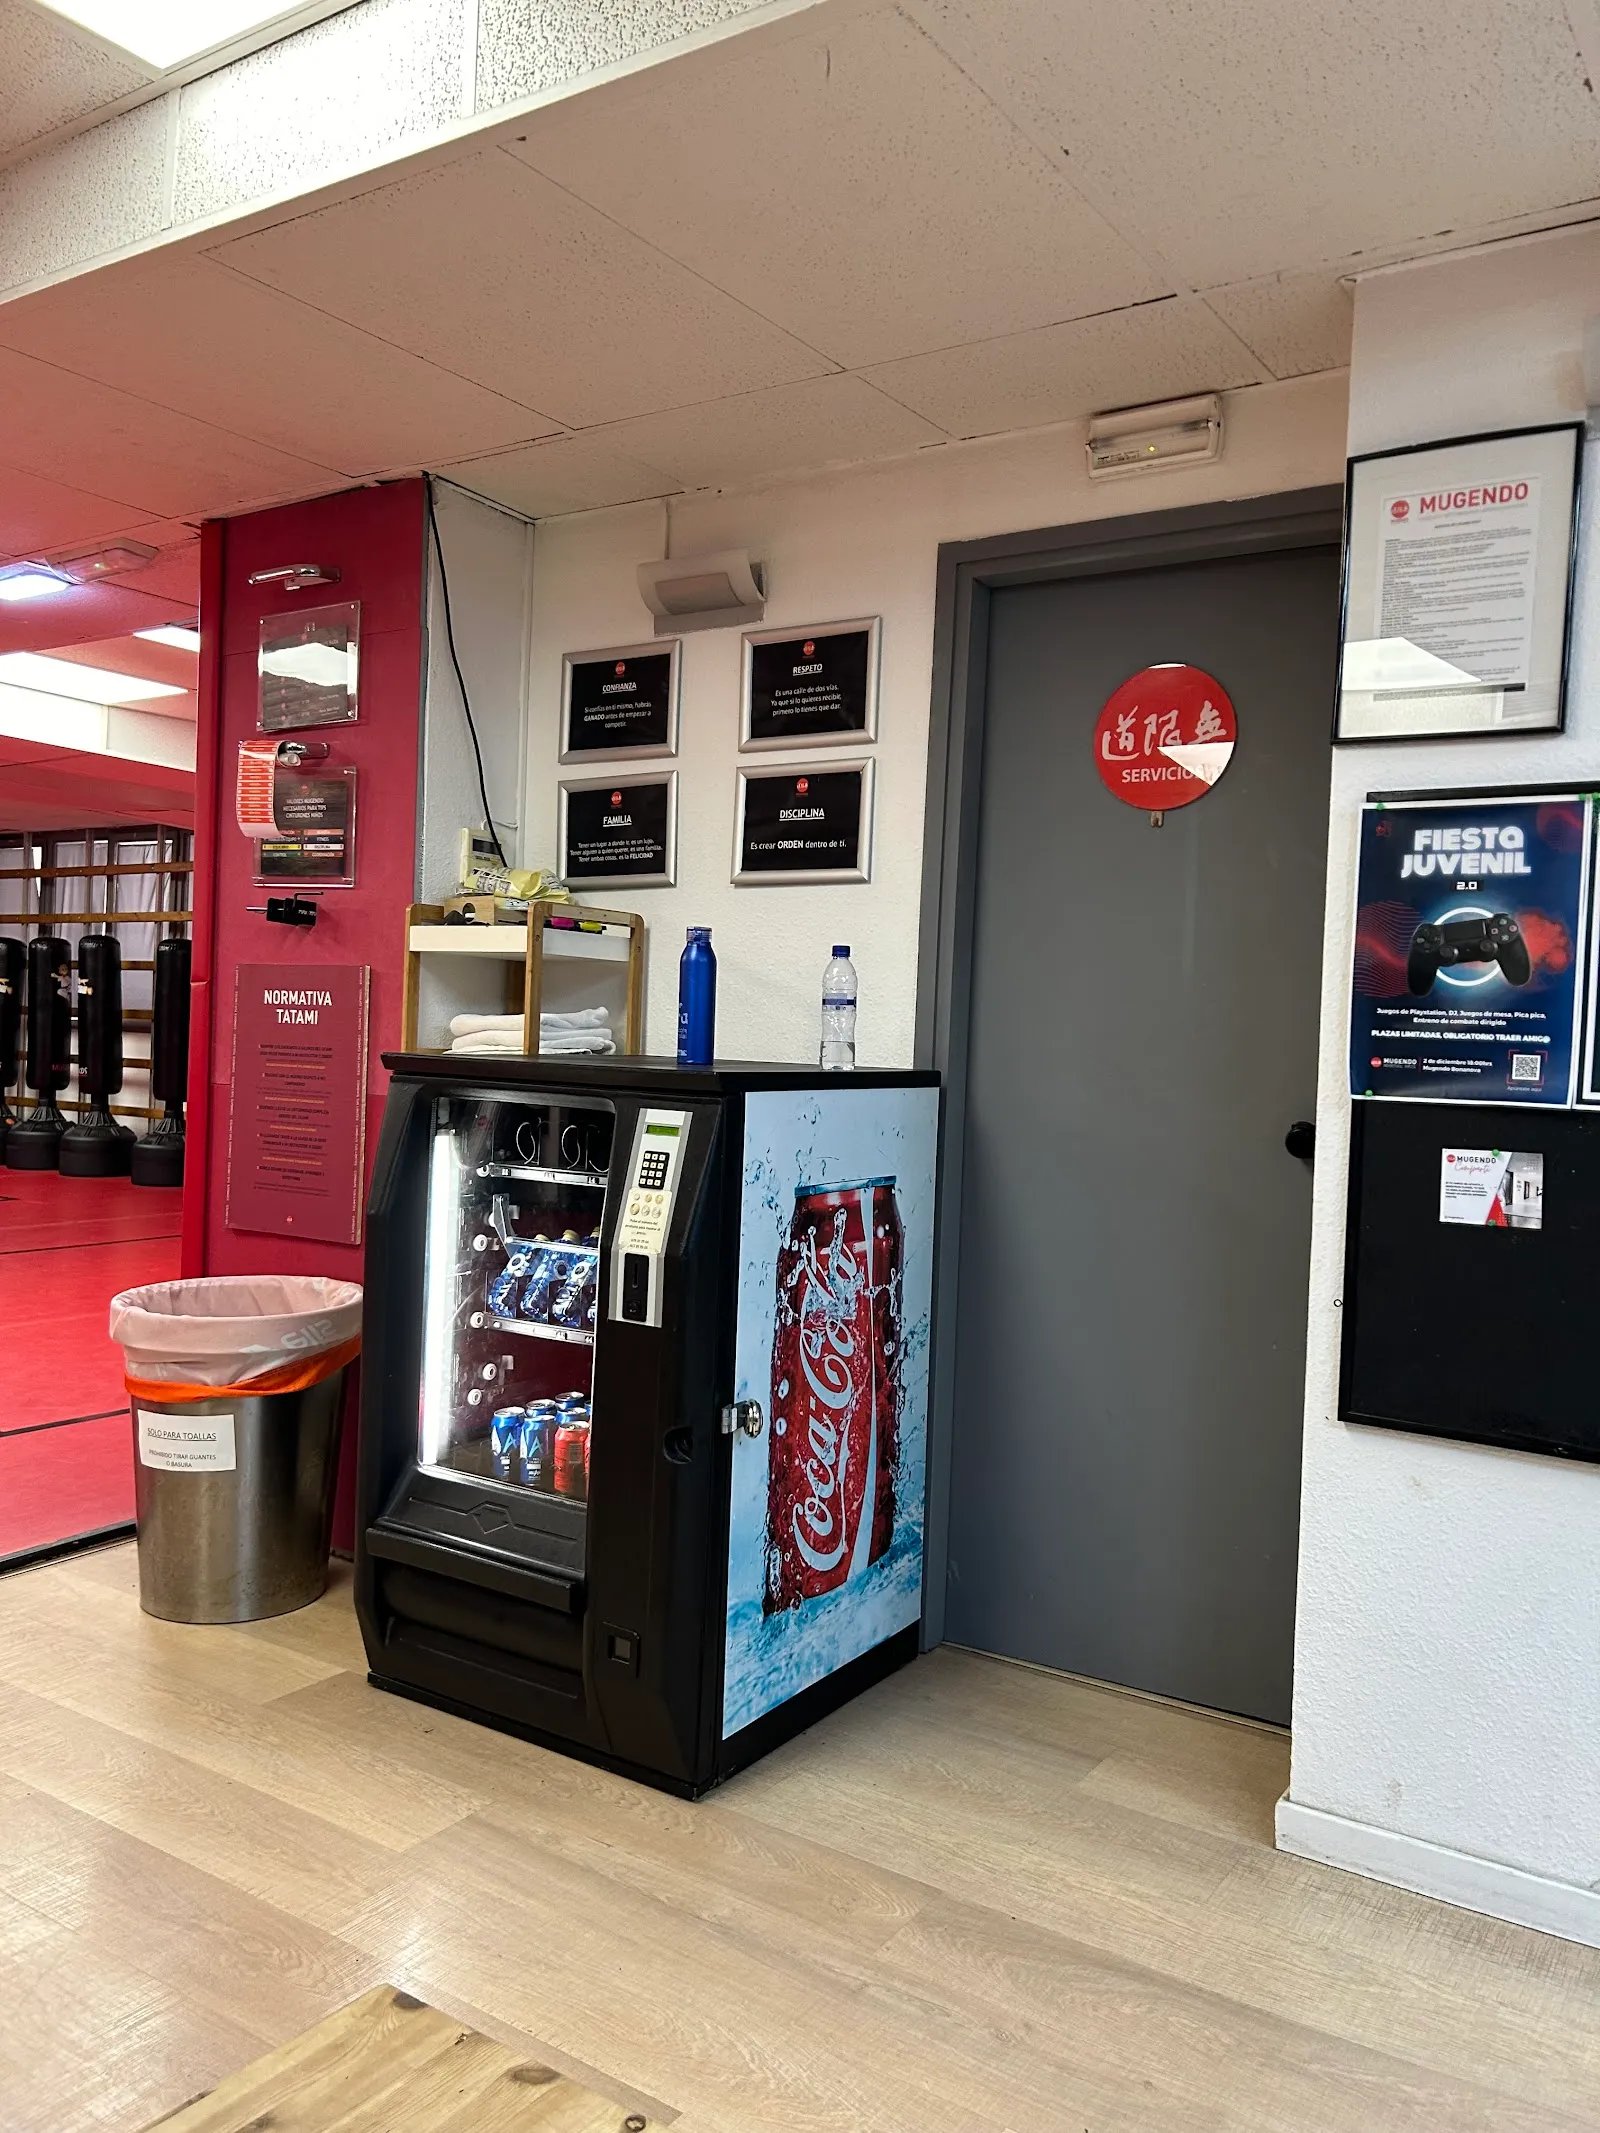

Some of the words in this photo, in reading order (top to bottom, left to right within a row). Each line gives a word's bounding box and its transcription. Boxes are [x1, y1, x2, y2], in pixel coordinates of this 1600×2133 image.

[1420, 483, 1528, 513] MUGENDO
[793, 663, 823, 674] RESPETO
[602, 682, 637, 693] CONFIANZA
[778, 699, 789, 707] que
[801, 696, 822, 704] quieres
[772, 708, 794, 717] primero
[801, 705, 818, 713] tienes
[818, 704, 829, 712] que
[1121, 766, 1200, 783] SERVICIO
[780, 808, 825, 818] DISCIPLINA
[603, 815, 632, 824] FAMILIA
[1414, 826, 1524, 851] FIESTA
[777, 840, 804, 849] ORDEN
[805, 840, 828, 848] dentro
[1401, 852, 1532, 878] JUVENIL
[1456, 882, 1478, 890] 2.0
[264, 990, 332, 1006] NORMATIVA
[1376, 1007, 1400, 1015] Juegos
[276, 1009, 318, 1025] TATAMI
[1443, 1032, 1494, 1040] OBLIGATORIO
[1457, 1155, 1497, 1164] MUGENDO
[147, 1428, 162, 1438] SOLO
[163, 1431, 181, 1439] PARA
[149, 1449, 172, 1459] PROHIBIDO
